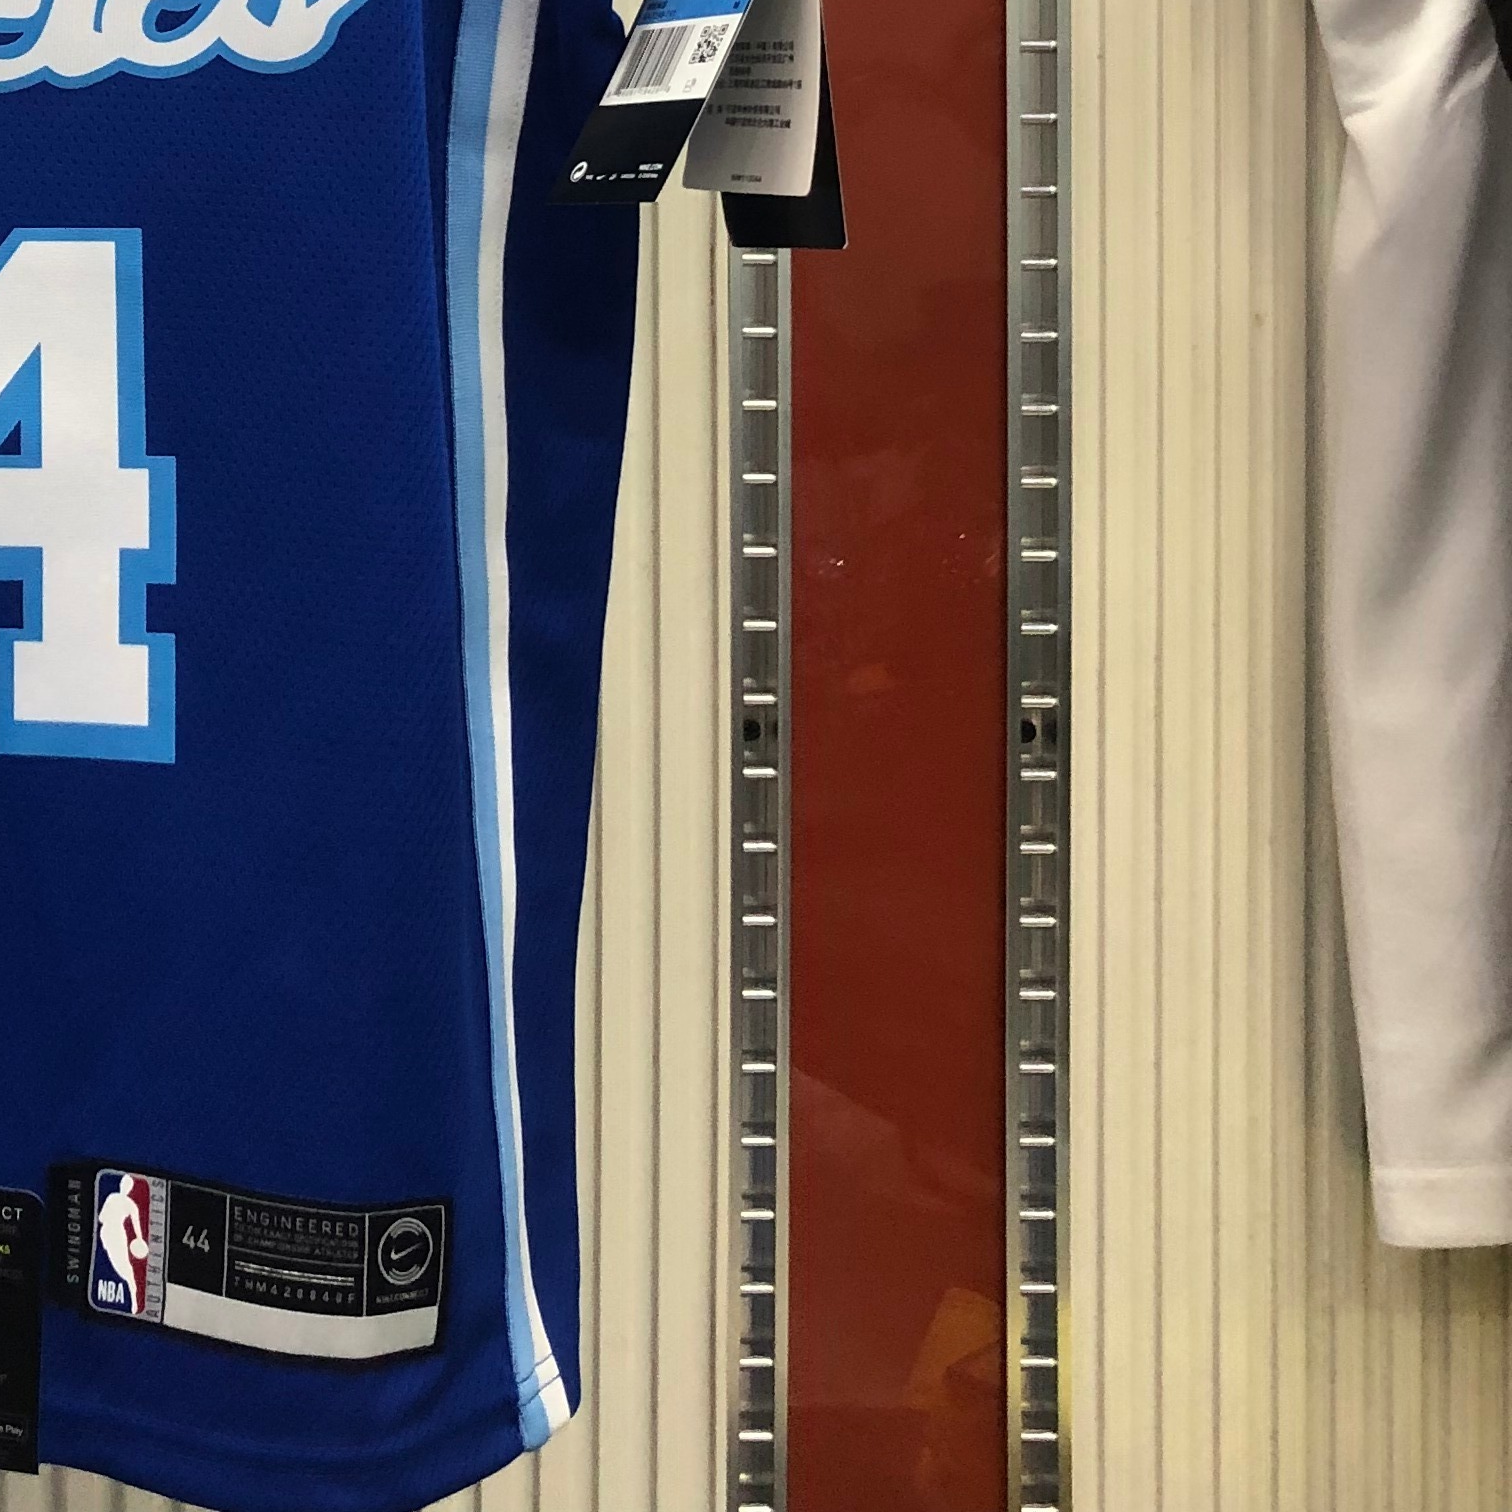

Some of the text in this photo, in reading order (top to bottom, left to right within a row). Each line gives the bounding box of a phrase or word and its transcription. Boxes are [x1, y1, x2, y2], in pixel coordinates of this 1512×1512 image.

[66, 1179, 82, 1284] SWINGMAN
[234, 1206, 360, 1237] ENGINEERED
[146, 1179, 165, 1318] AUTHENTICS
[181, 1225, 211, 1254] 44
[97, 1279, 126, 1304] NBA
